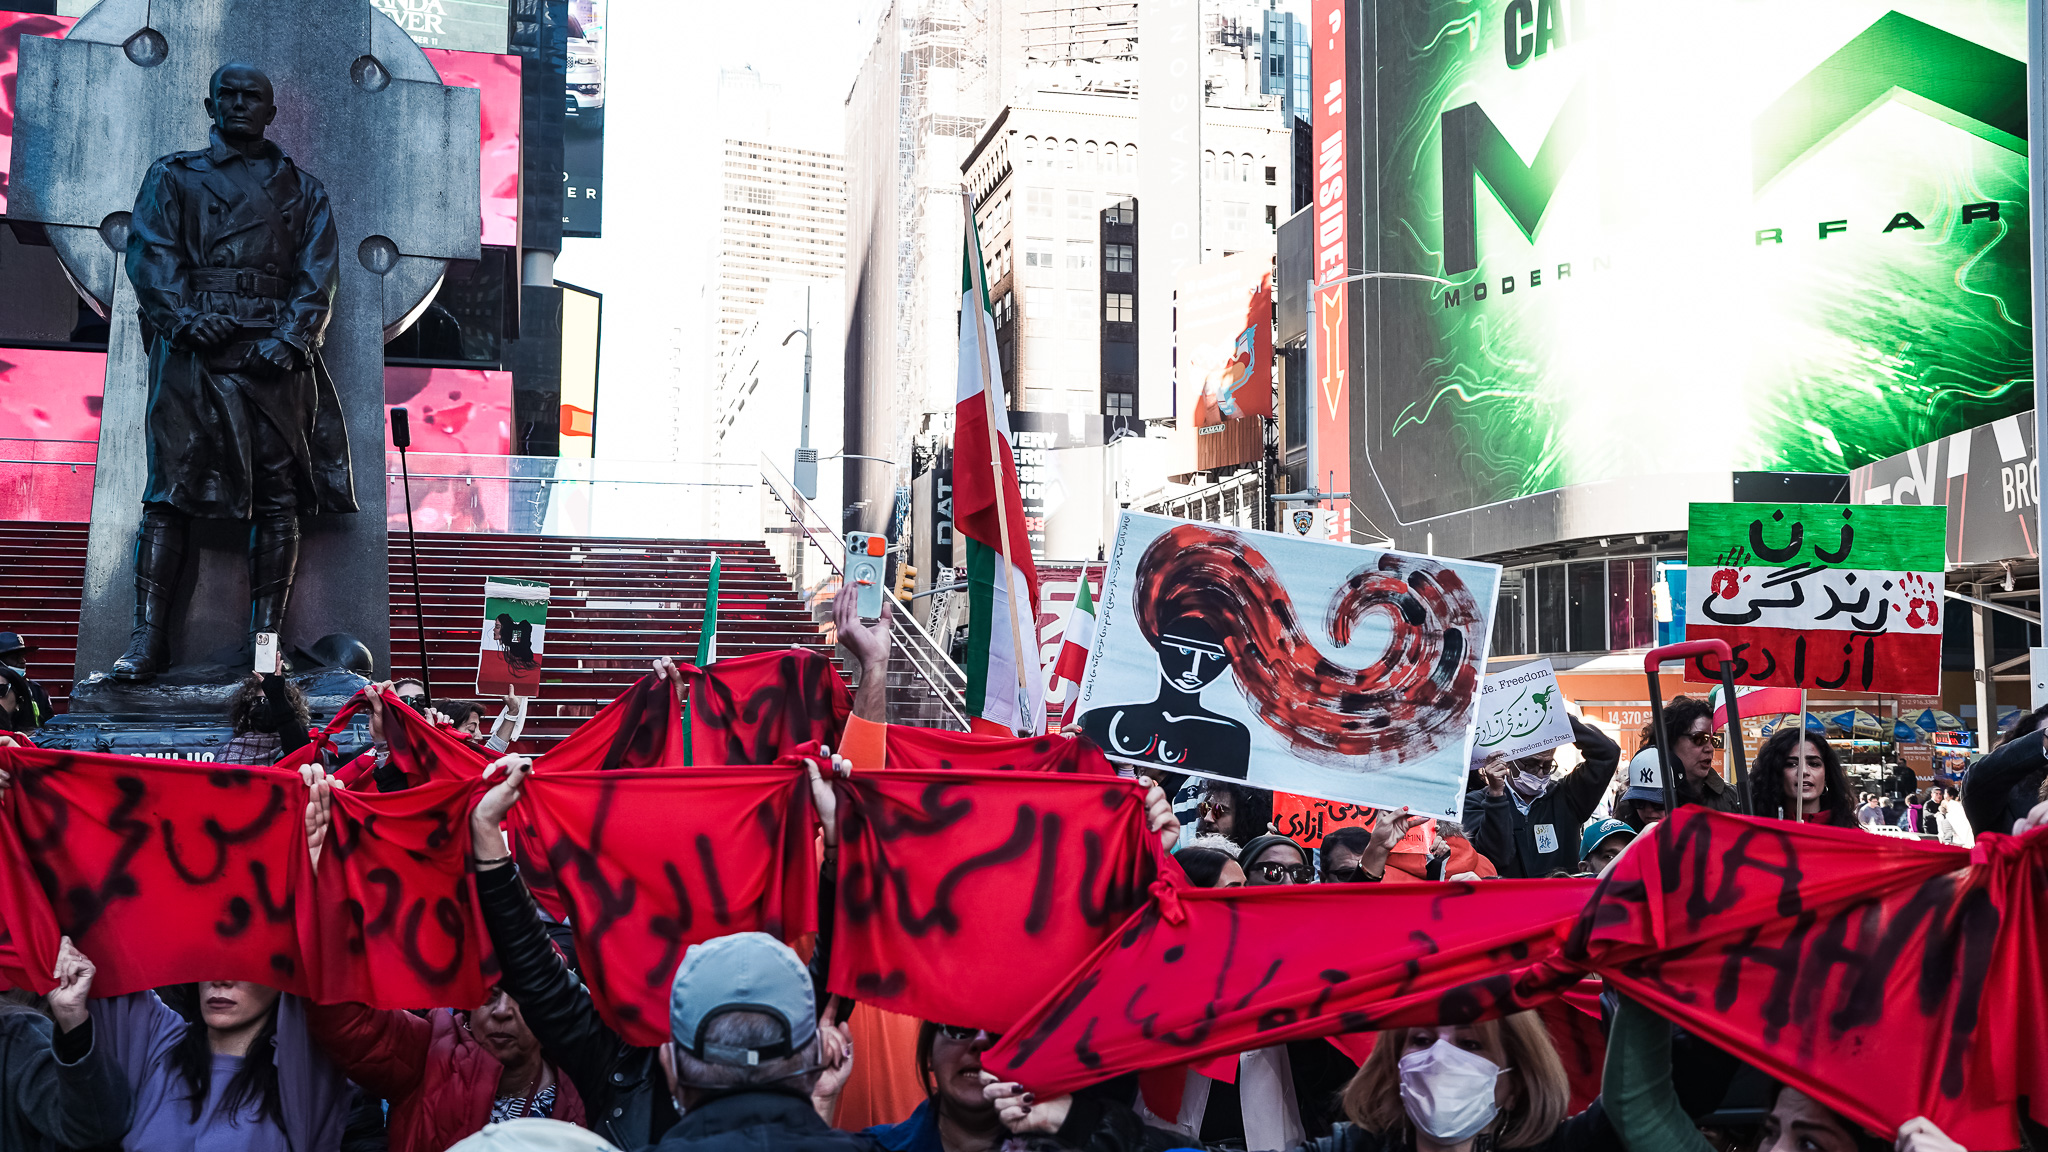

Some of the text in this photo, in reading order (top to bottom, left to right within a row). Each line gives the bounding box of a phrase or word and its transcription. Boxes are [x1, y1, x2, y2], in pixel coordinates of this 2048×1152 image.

[1199, 424, 1226, 435] LAMAR
[1749, 507, 1855, 564] زن
[1701, 561, 1894, 631] زندگی
[1695, 628, 1888, 692] آزادی
[1498, 668, 1552, 690] Freedom.
[1608, 711, 1641, 725] 14,370
[1511, 732, 1573, 756] Freedom for Iran.
[1273, 800, 1328, 843] آزادی
